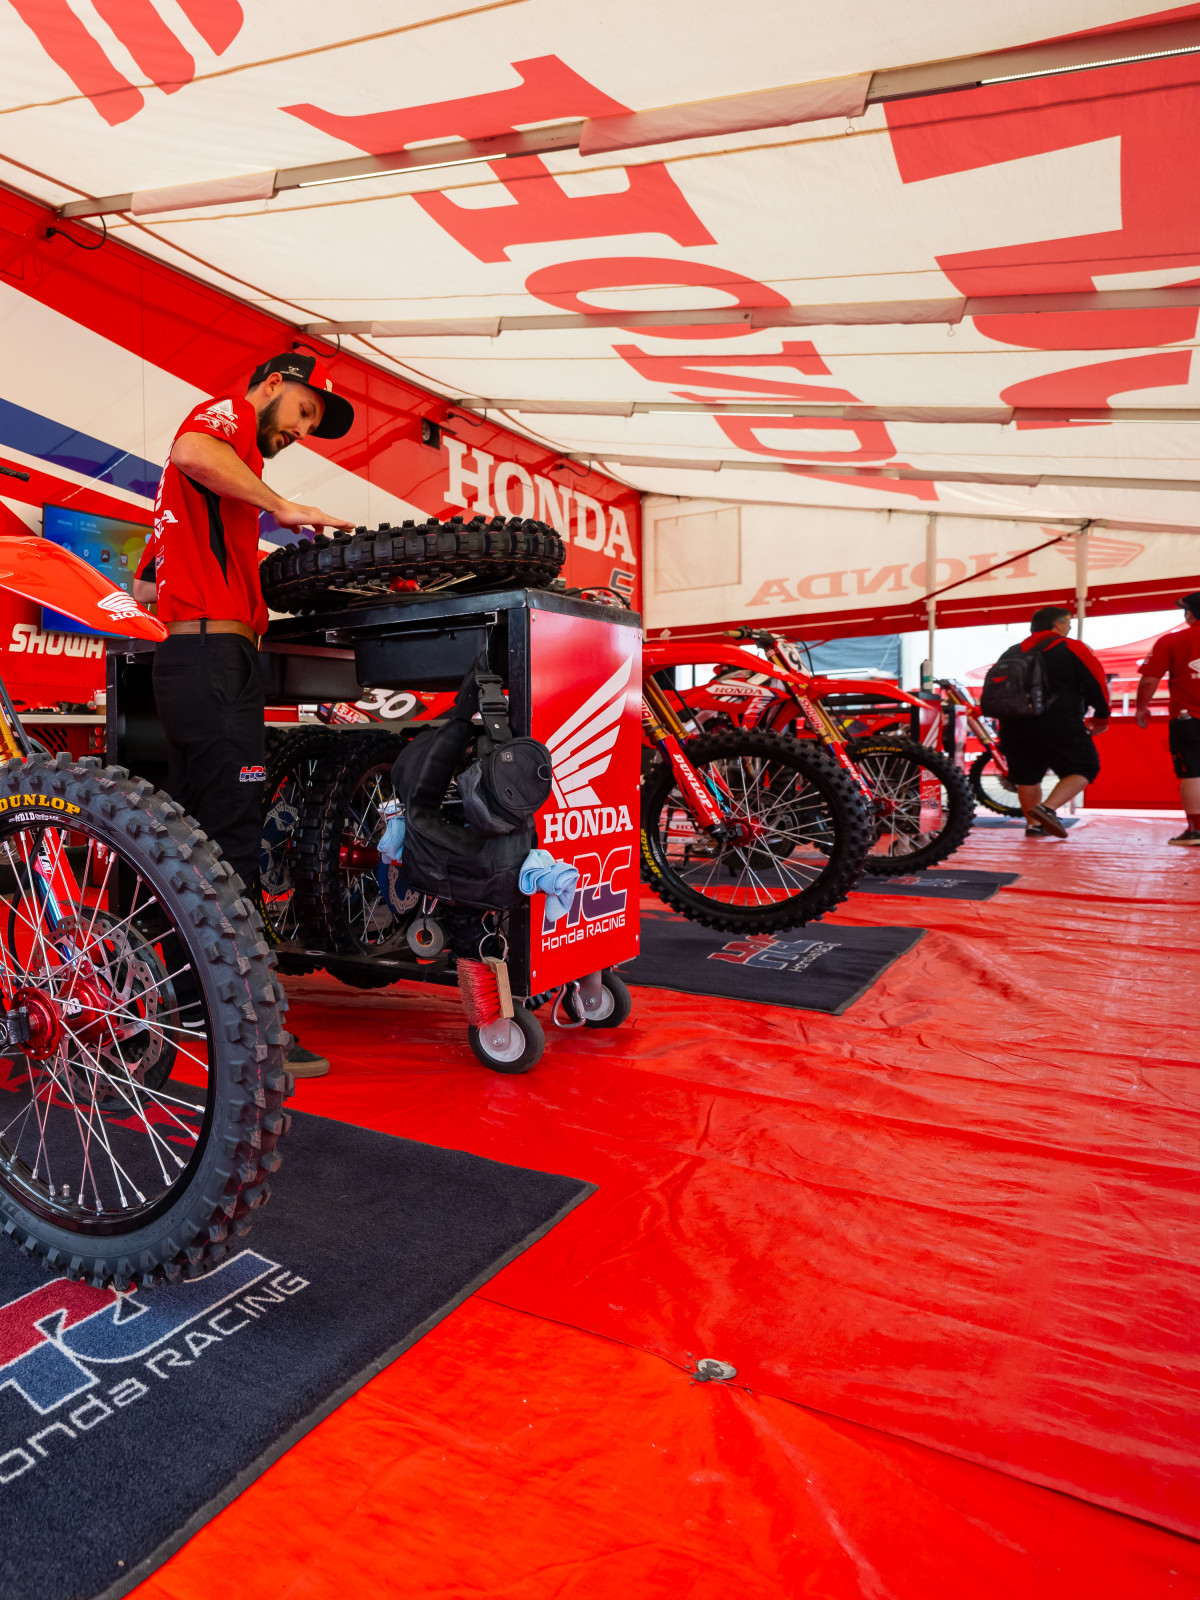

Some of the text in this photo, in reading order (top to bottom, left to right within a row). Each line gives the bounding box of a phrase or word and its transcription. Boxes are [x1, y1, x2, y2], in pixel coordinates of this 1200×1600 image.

[442, 435, 637, 565] HONDA
[8, 623, 105, 660] SHOWA
[354, 688, 417, 719] 30
[714, 687, 764, 696] HONDA
[672, 753, 713, 809] DUNLOP
[543, 804, 634, 844] HONDA
[541, 913, 626, 952] Honda RACING
[144, 1268, 311, 1379] RACING
